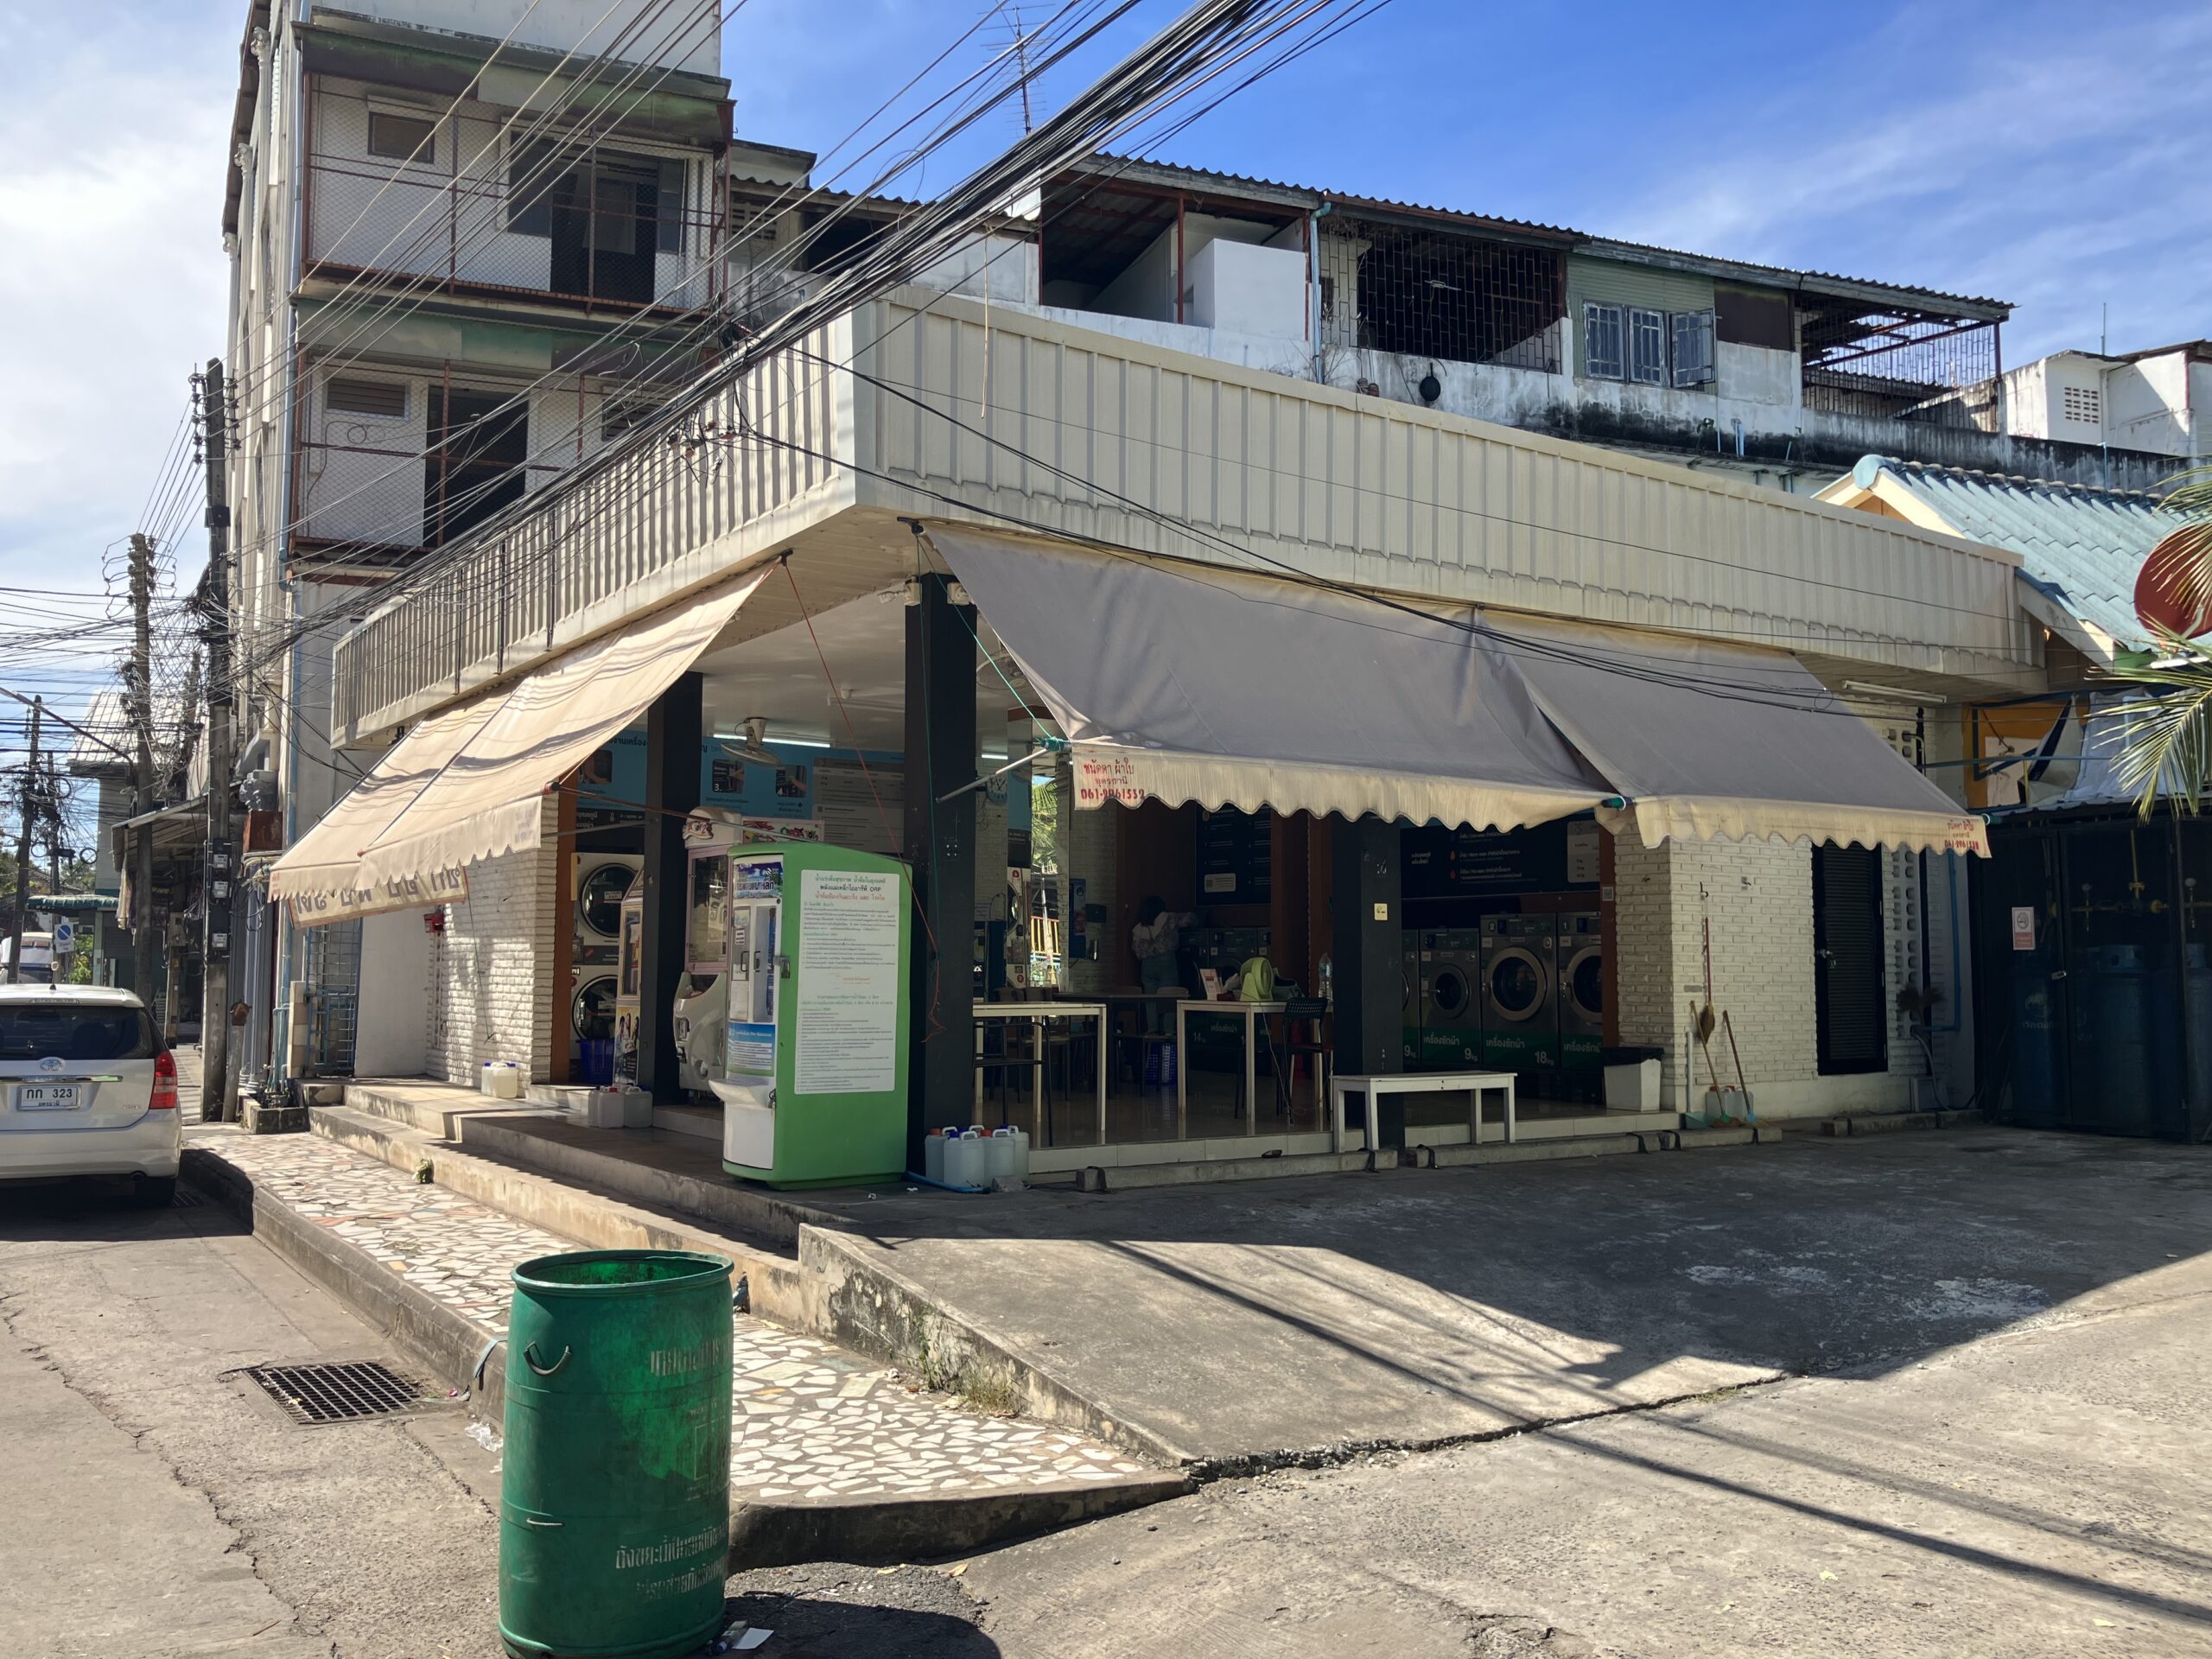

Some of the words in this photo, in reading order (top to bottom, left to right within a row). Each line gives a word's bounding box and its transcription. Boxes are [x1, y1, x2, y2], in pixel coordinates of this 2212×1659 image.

[1115, 757, 1135, 775] ผ้าใบ
[1423, 1032, 1460, 1046] เครื่องซักผ้า
[1486, 1034, 1526, 1050] เครื่องซักผ้า
[26, 1089, 43, 1099] กก
[52, 1088, 73, 1099] 323
